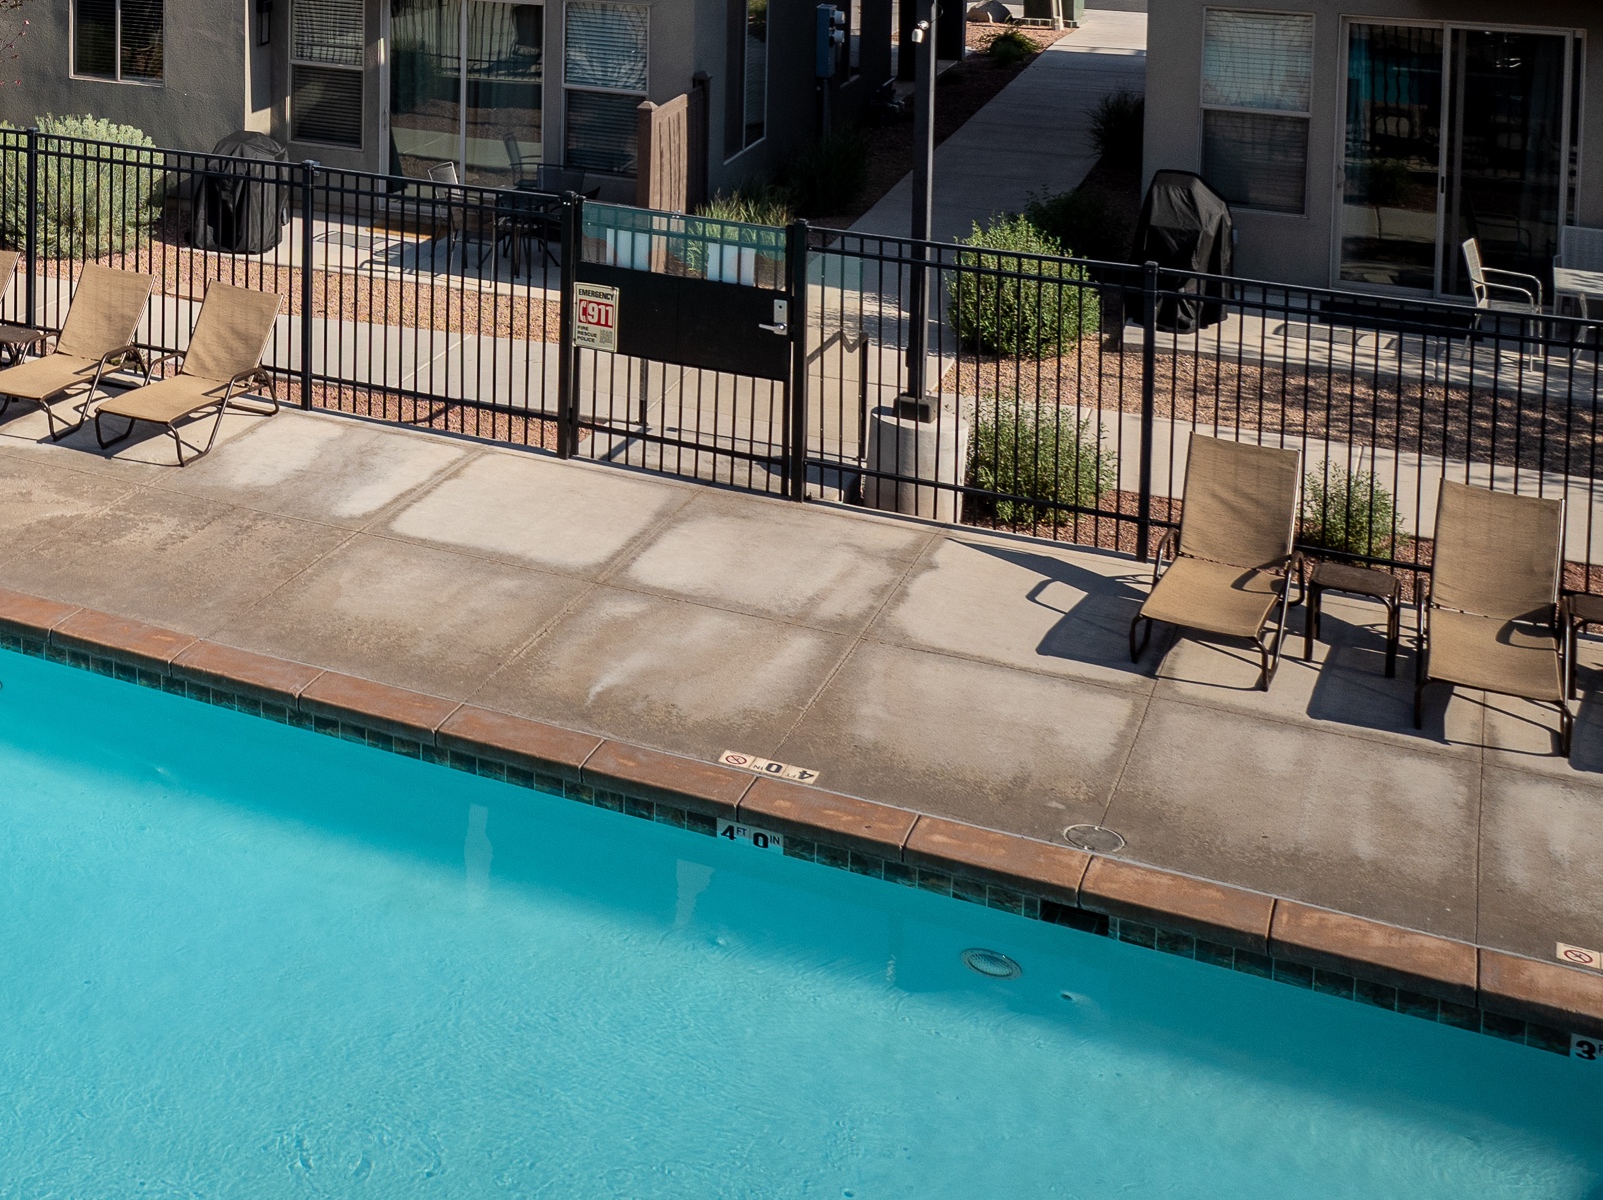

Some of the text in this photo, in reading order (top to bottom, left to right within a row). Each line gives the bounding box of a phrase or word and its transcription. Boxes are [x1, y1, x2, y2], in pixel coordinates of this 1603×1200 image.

[578, 288, 614, 301] EMERGENCY
[588, 302, 613, 326] 911
[577, 330, 597, 338] RESCUE
[577, 335, 596, 343] POLICE
[765, 763, 783, 773] 0
[798, 770, 814, 780] 4
[720, 824, 780, 848] 4 FT 0 IN
[1575, 1040, 1596, 1060] 3
